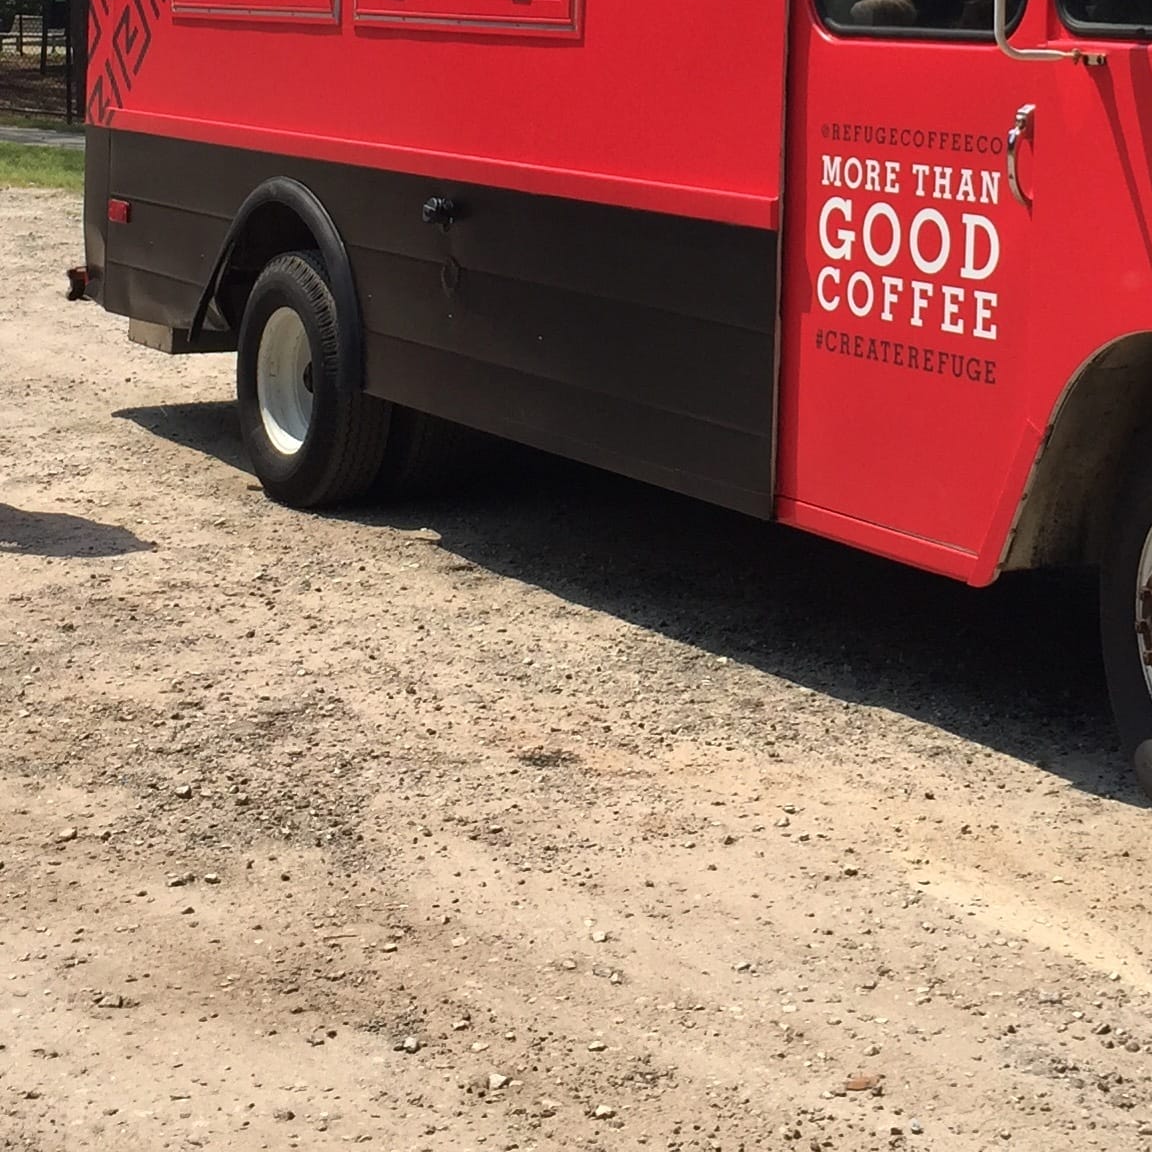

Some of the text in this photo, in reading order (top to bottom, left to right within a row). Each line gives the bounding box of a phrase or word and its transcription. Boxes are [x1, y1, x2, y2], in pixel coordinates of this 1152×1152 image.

[821, 123, 1003, 155] @REFUGECOFFEECO
[821, 155, 1000, 205] MORE THAN
[819, 196, 1000, 280] GOOD
[817, 266, 998, 340] COFFEE
[816, 329, 996, 385] #CREATEREFUGE
